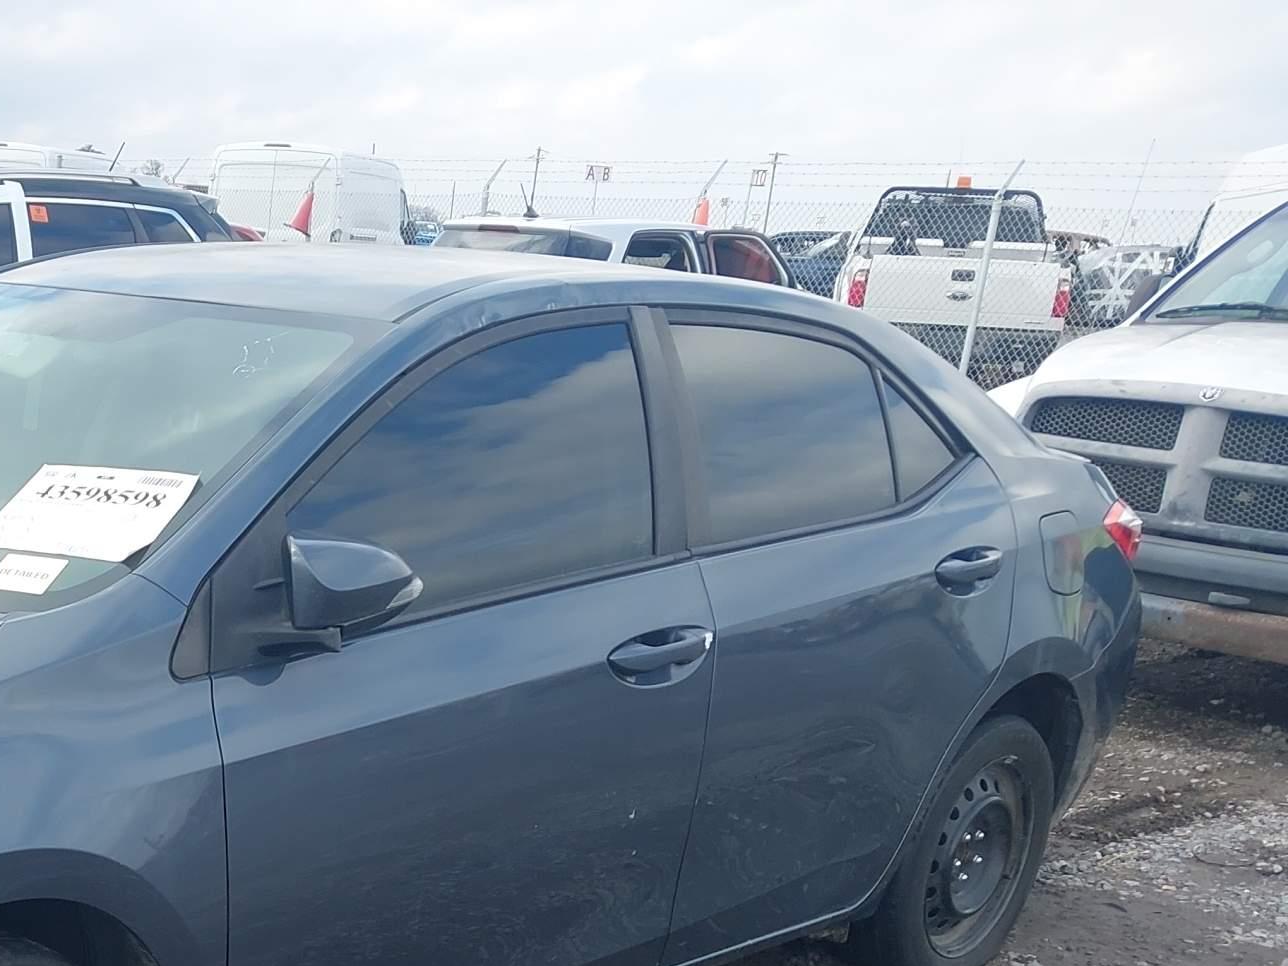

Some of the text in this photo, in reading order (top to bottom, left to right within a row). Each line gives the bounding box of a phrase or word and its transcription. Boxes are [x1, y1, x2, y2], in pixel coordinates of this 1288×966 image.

[585, 165, 610, 181] A B
[36, 484, 167, 509] 43598598
